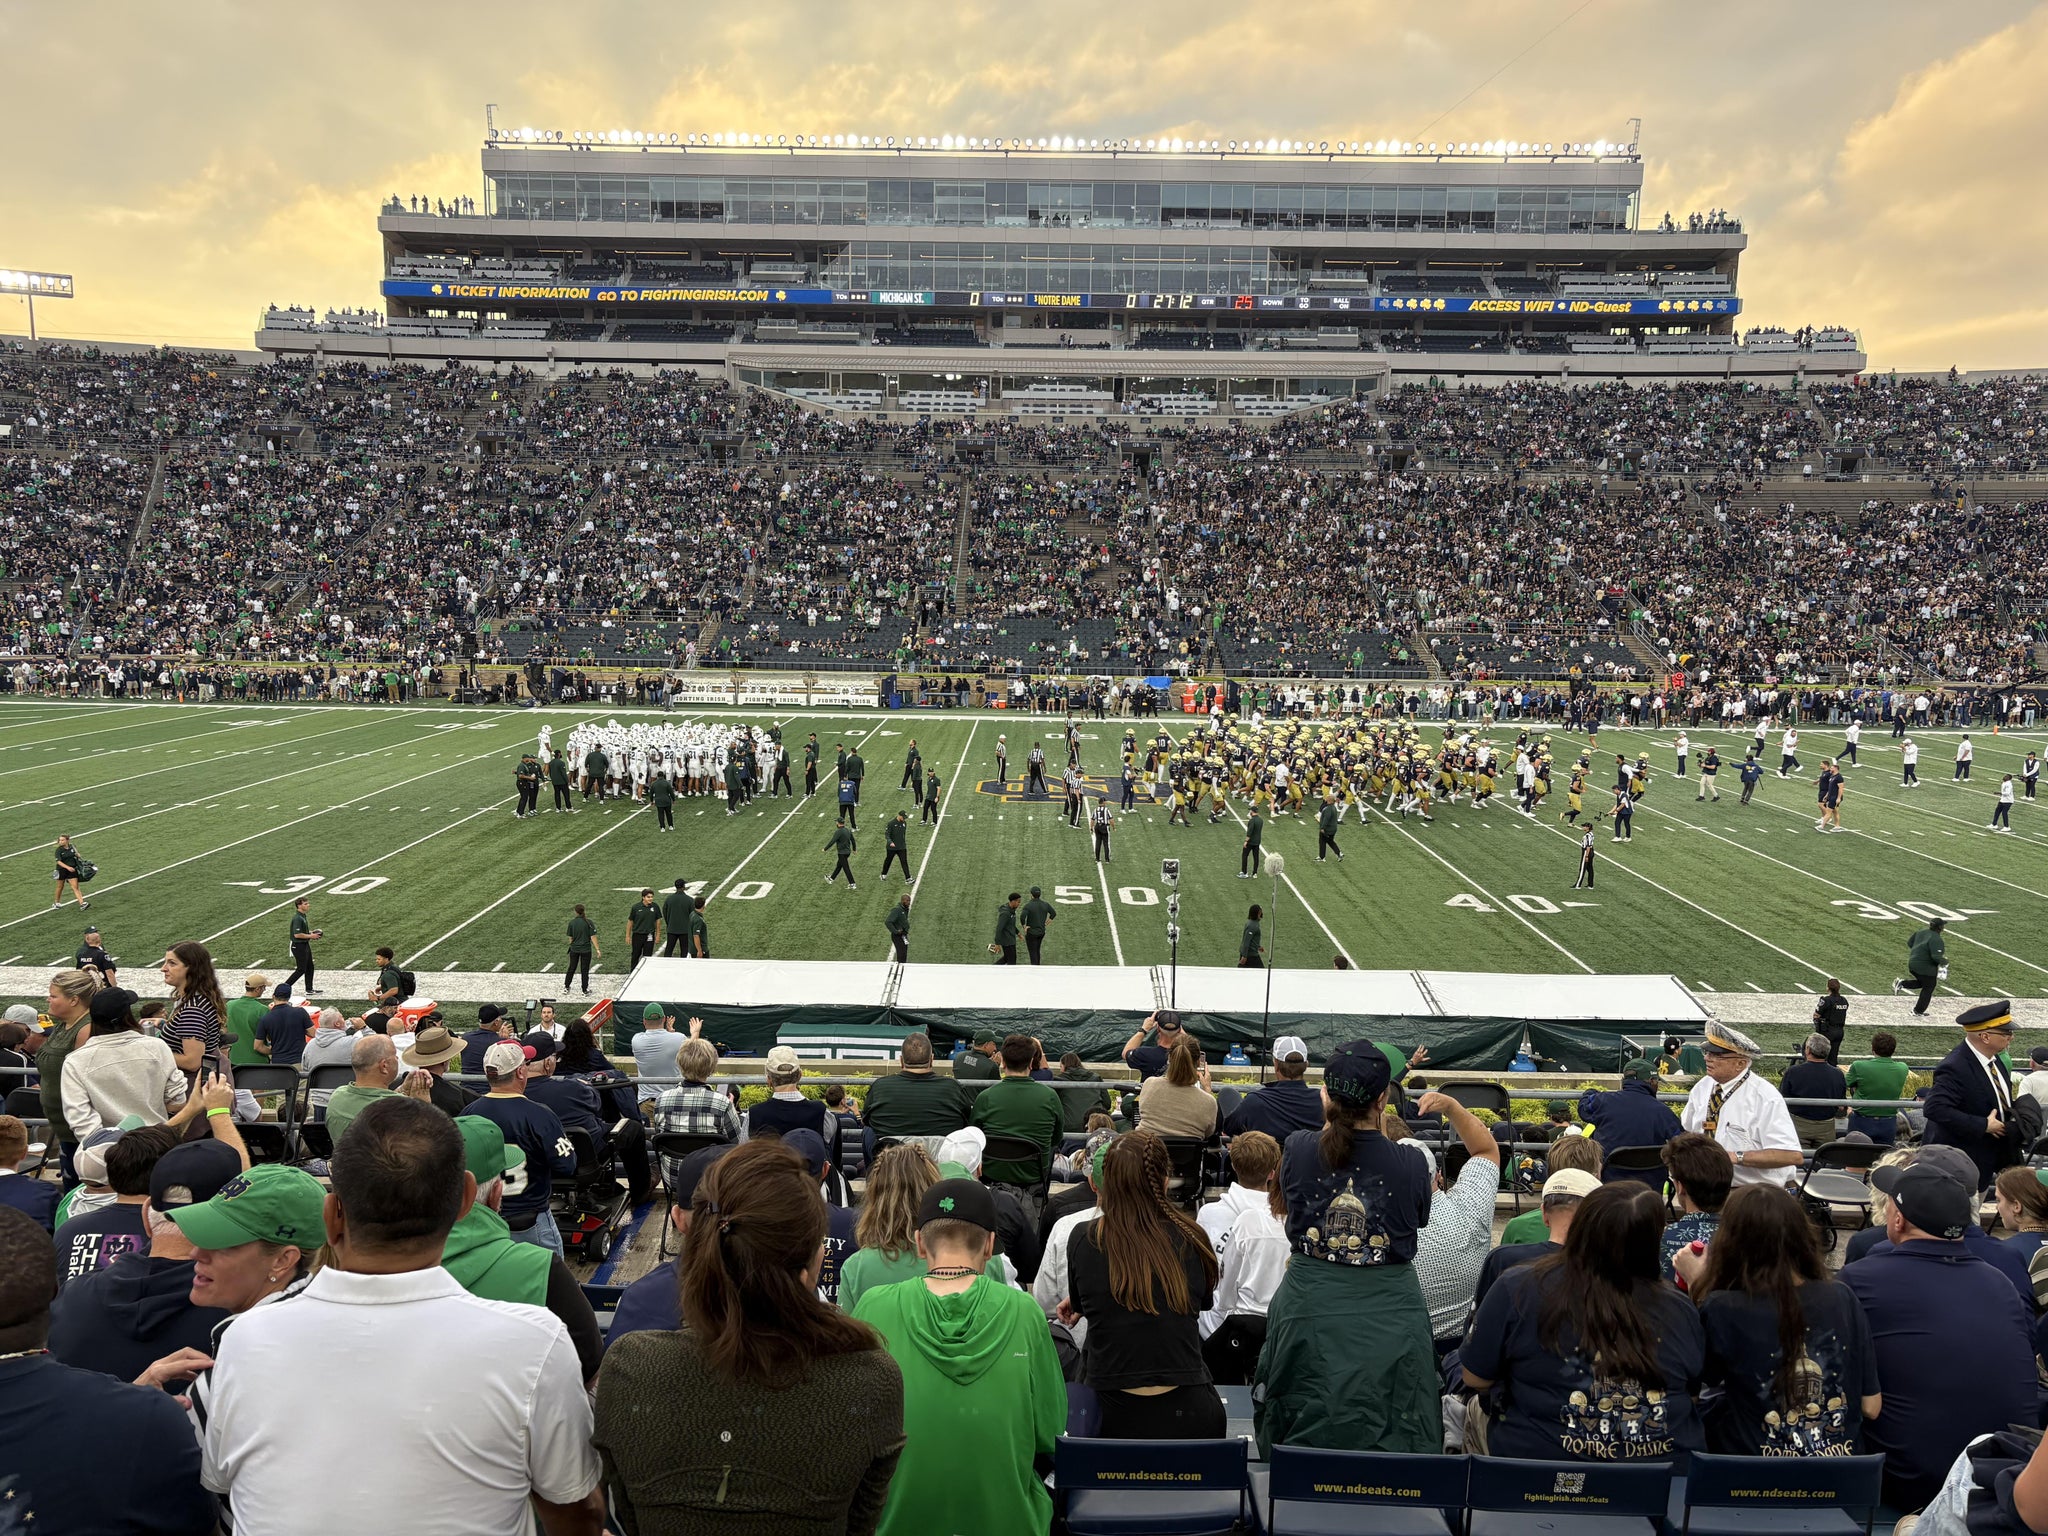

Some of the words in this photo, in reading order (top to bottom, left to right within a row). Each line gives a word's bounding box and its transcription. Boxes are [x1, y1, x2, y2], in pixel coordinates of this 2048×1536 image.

[448, 285, 496, 297] TICKET
[498, 286, 590, 299] INFORMATION
[597, 291, 617, 301] GO
[620, 291, 638, 301] TO
[640, 289, 769, 301] FIGHTINGIRISH.COM
[879, 292, 913, 304] MICHIGAN
[914, 292, 925, 304] ST.
[969, 292, 980, 306] 0
[1038, 295, 1061, 306] NOTRE
[1061, 295, 1081, 306] DAME
[1126, 294, 1137, 308] 0
[1153, 294, 1193, 309] 27:12
[1235, 296, 1253, 309] 25
[1468, 300, 1521, 312] ACCESS
[1524, 301, 1555, 312] WIFI
[1569, 301, 1632, 313] ND-Guest
[688, 751, 697, 759] 31
[258, 875, 390, 895] 30
[1054, 885, 1160, 906] 50
[1443, 893, 1563, 914] 40
[1830, 900, 1970, 921] 30
[1653, 1405, 1664, 1420] 2
[1832, 1412, 1842, 1427] 2
[1600, 1418, 1610, 1435] 8
[1627, 1419, 1639, 1435] 4
[1810, 1426, 1821, 1441] 4
[1586, 1433, 1615, 1441] LOVE
[1560, 1434, 1620, 1459] NOTRE
[1623, 1437, 1675, 1458] DAME
[1096, 1470, 1202, 1481] www.ndseats.com
[1313, 1484, 1421, 1498] www.ndseats.com
[1730, 1488, 1836, 1498] www.ndseats.com
[1524, 1493, 1609, 1504] FightingIrish.com/Seats
